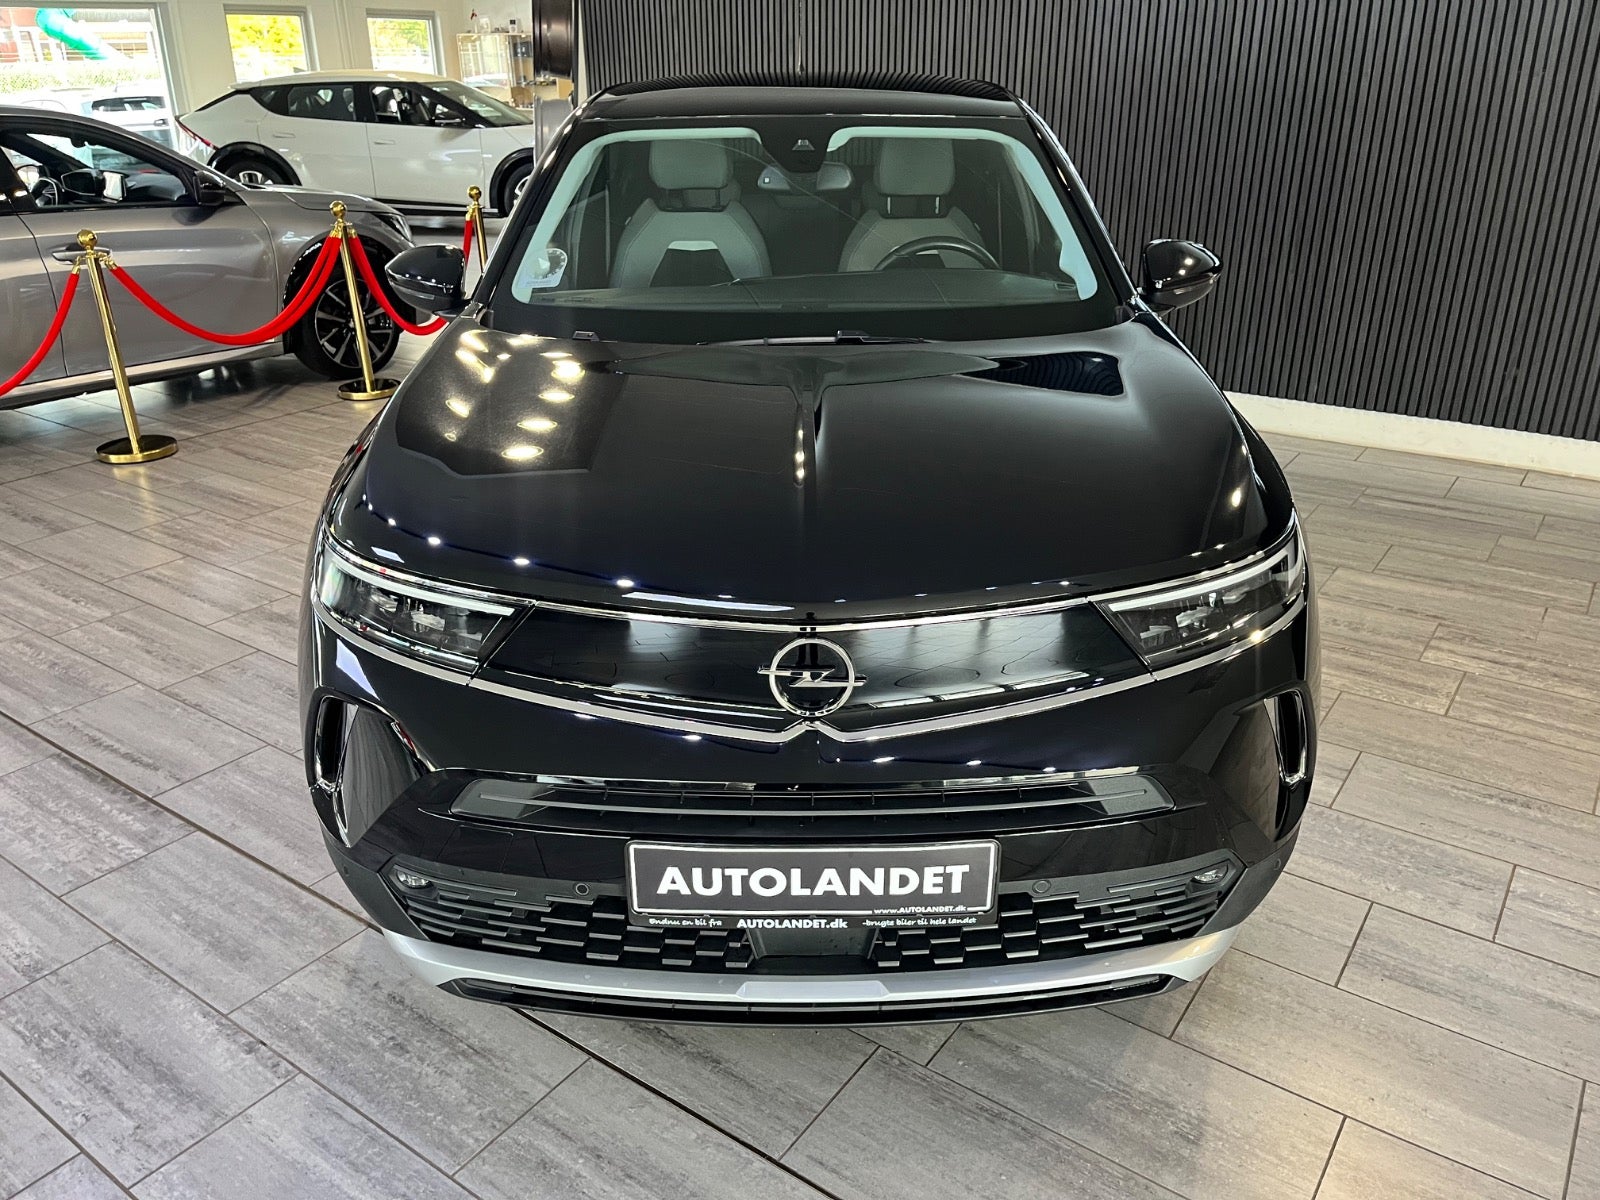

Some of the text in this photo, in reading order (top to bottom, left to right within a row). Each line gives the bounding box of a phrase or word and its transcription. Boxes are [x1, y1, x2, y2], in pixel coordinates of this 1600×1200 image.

[656, 865, 970, 897] AUTOLANDET
[873, 905, 967, 914] www.AUTOLANDET.dk
[649, 918, 680, 926] Endnu
[695, 918, 707, 926] bil
[709, 918, 722, 928] fra
[736, 918, 848, 929] AUTOLANDET.dk
[896, 918, 916, 926] biler
[917, 917, 928, 926] til
[930, 917, 946, 925] hele
[948, 916, 977, 924] landet
